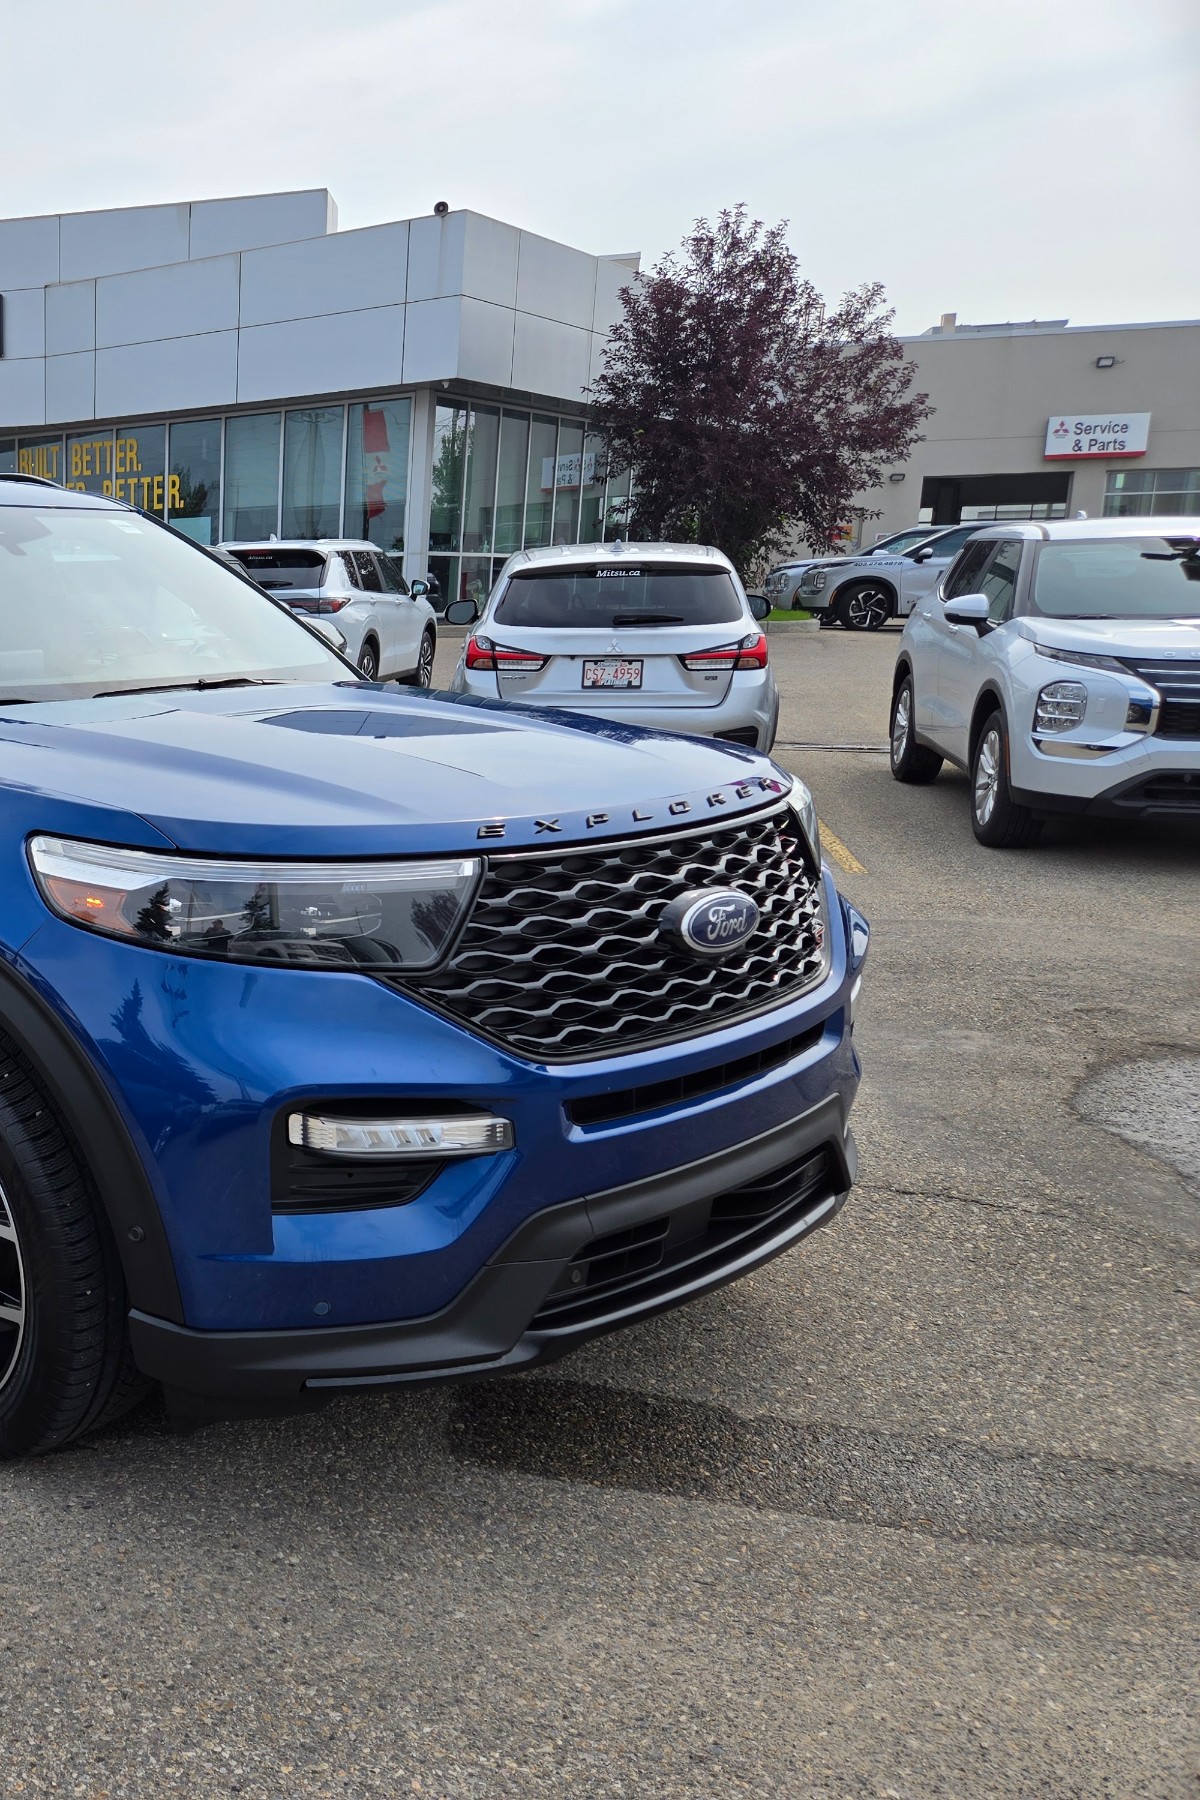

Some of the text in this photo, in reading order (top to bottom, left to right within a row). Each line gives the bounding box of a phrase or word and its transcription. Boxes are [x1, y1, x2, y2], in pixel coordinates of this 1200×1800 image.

[1073, 420, 1129, 435] Service
[1072, 438, 1126, 452] & Parts
[19, 438, 143, 479] BUILT BETTER.
[596, 569, 641, 578] Mitsu.ca
[476, 776, 776, 840] EXPLORER
[707, 904, 748, 941] Ford
